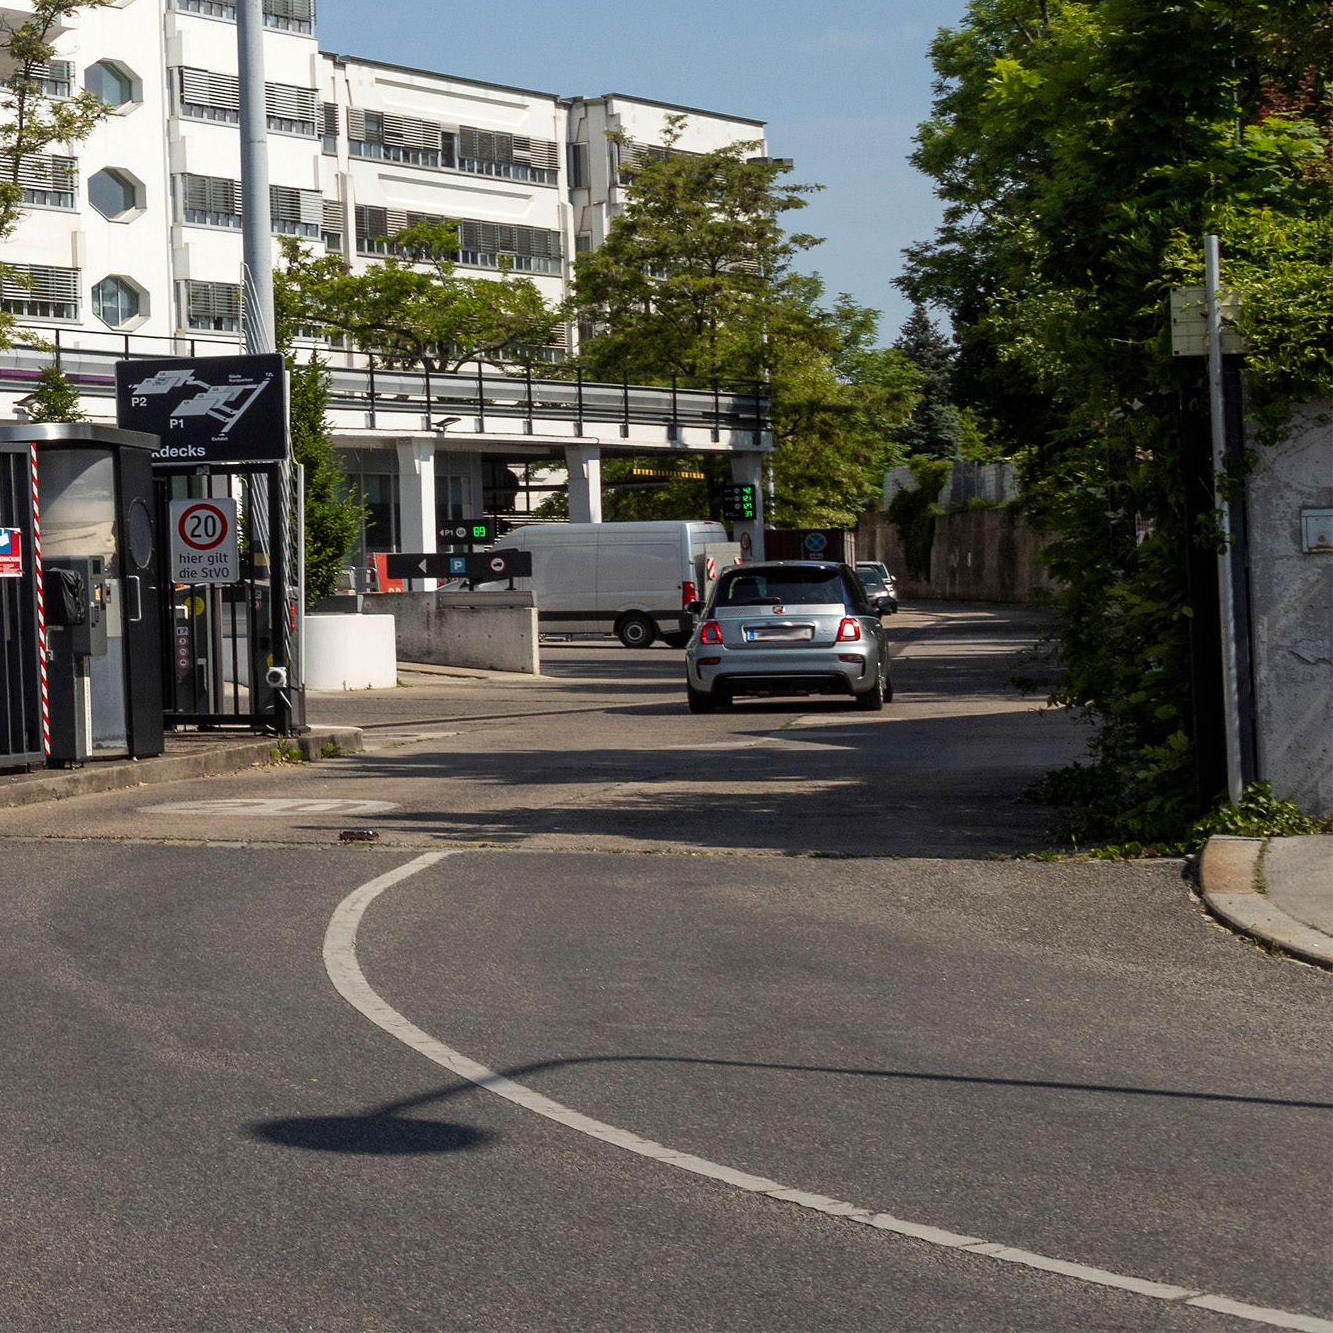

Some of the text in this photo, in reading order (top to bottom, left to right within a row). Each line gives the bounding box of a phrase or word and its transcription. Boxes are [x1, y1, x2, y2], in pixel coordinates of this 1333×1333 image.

[131, 397, 147, 407] P2
[169, 419, 184, 429] P1
[190, 515, 216, 538] 20
[179, 553, 228, 565] hier gilt
[454, 561, 463, 570] P
[179, 567, 229, 579] die StVO
